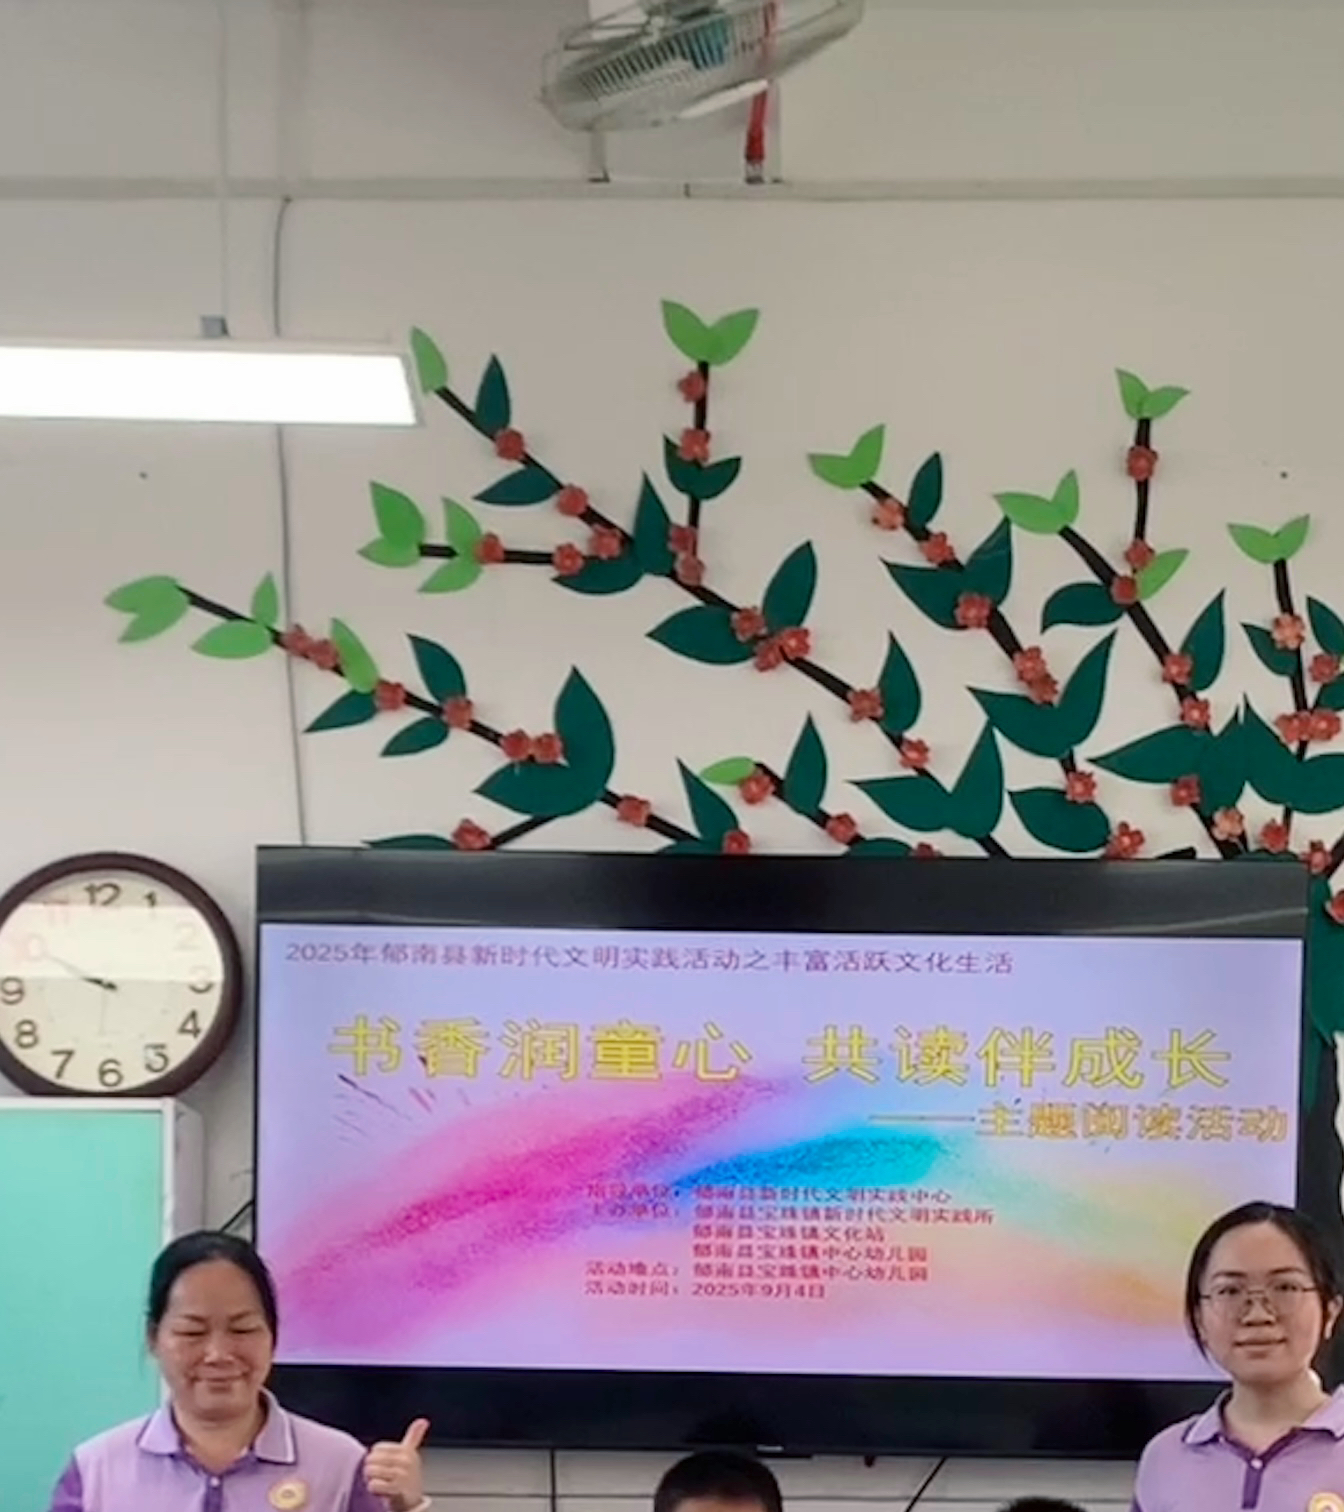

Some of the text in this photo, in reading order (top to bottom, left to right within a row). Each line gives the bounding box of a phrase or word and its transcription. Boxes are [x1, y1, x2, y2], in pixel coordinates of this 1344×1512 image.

[285, 942, 1013, 974] 2025年郁南县新时代文明实践活动之丰富活跃文化生活
[0, 977, 24, 1005] 9
[15, 1020, 39, 1049] 8
[178, 1010, 202, 1039] 4
[51, 1050, 75, 1080] 7
[144, 1044, 170, 1073] 5
[327, 1013, 1231, 1089] 书香润童心 共读伴成长
[98, 1059, 124, 1088] 6
